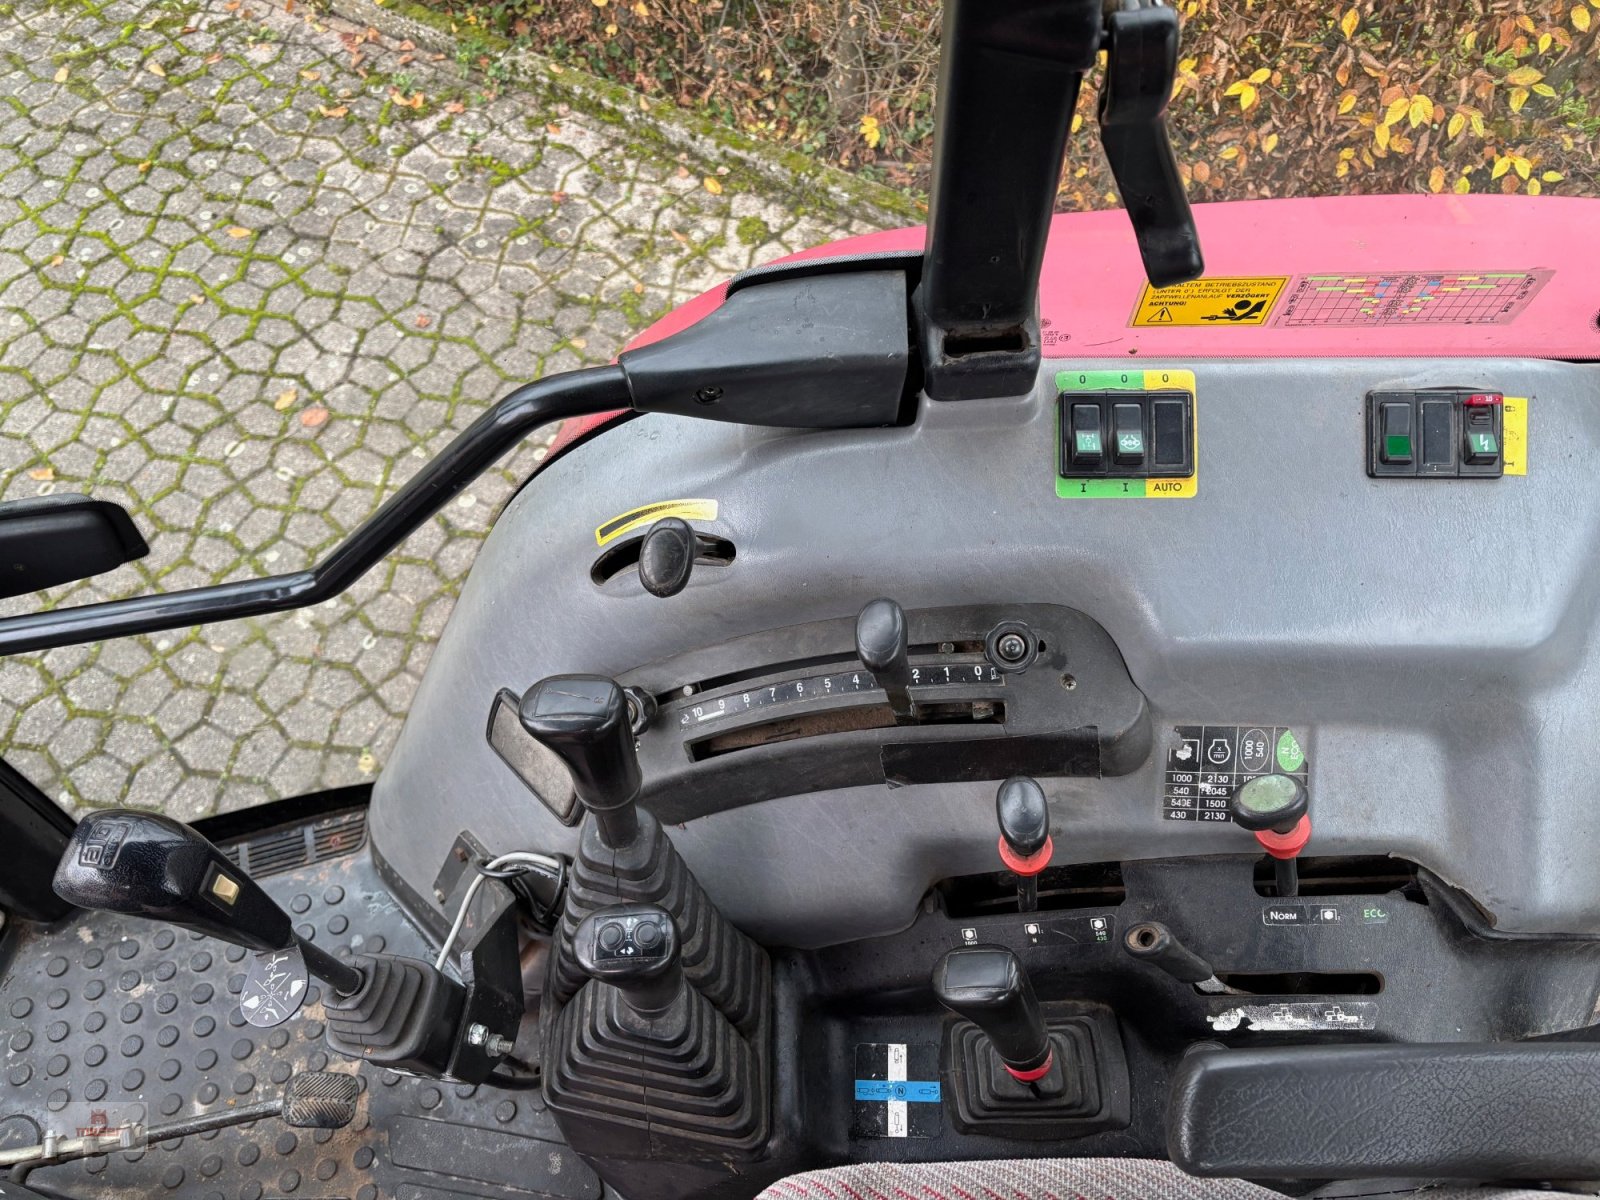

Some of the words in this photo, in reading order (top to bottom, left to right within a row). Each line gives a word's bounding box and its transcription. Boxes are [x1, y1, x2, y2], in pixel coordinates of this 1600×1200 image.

[1153, 482, 1183, 492] AUTO
[691, 707, 703, 718] 10
[718, 699, 725, 709] 9
[743, 693, 750, 703] 8
[769, 687, 776, 697] 7
[796, 682, 803, 693] 6
[824, 678, 831, 688] 5
[852, 674, 860, 684] 4
[912, 668, 920, 679] 2
[943, 667, 950, 676] 1
[974, 665, 982, 676] 0
[1244, 740, 1254, 760] 1000
[1255, 741, 1265, 758] 540
[1281, 747, 1290, 755] N
[1172, 774, 1192, 783] 1000
[1207, 775, 1229, 783] 2130
[1173, 786, 1189, 795] 540
[1206, 787, 1227, 796] 2045
[1205, 800, 1226, 808] 1500
[1170, 811, 1187, 819] 430
[1204, 811, 1226, 820] 2130
[897, 1087, 904, 1095] N
